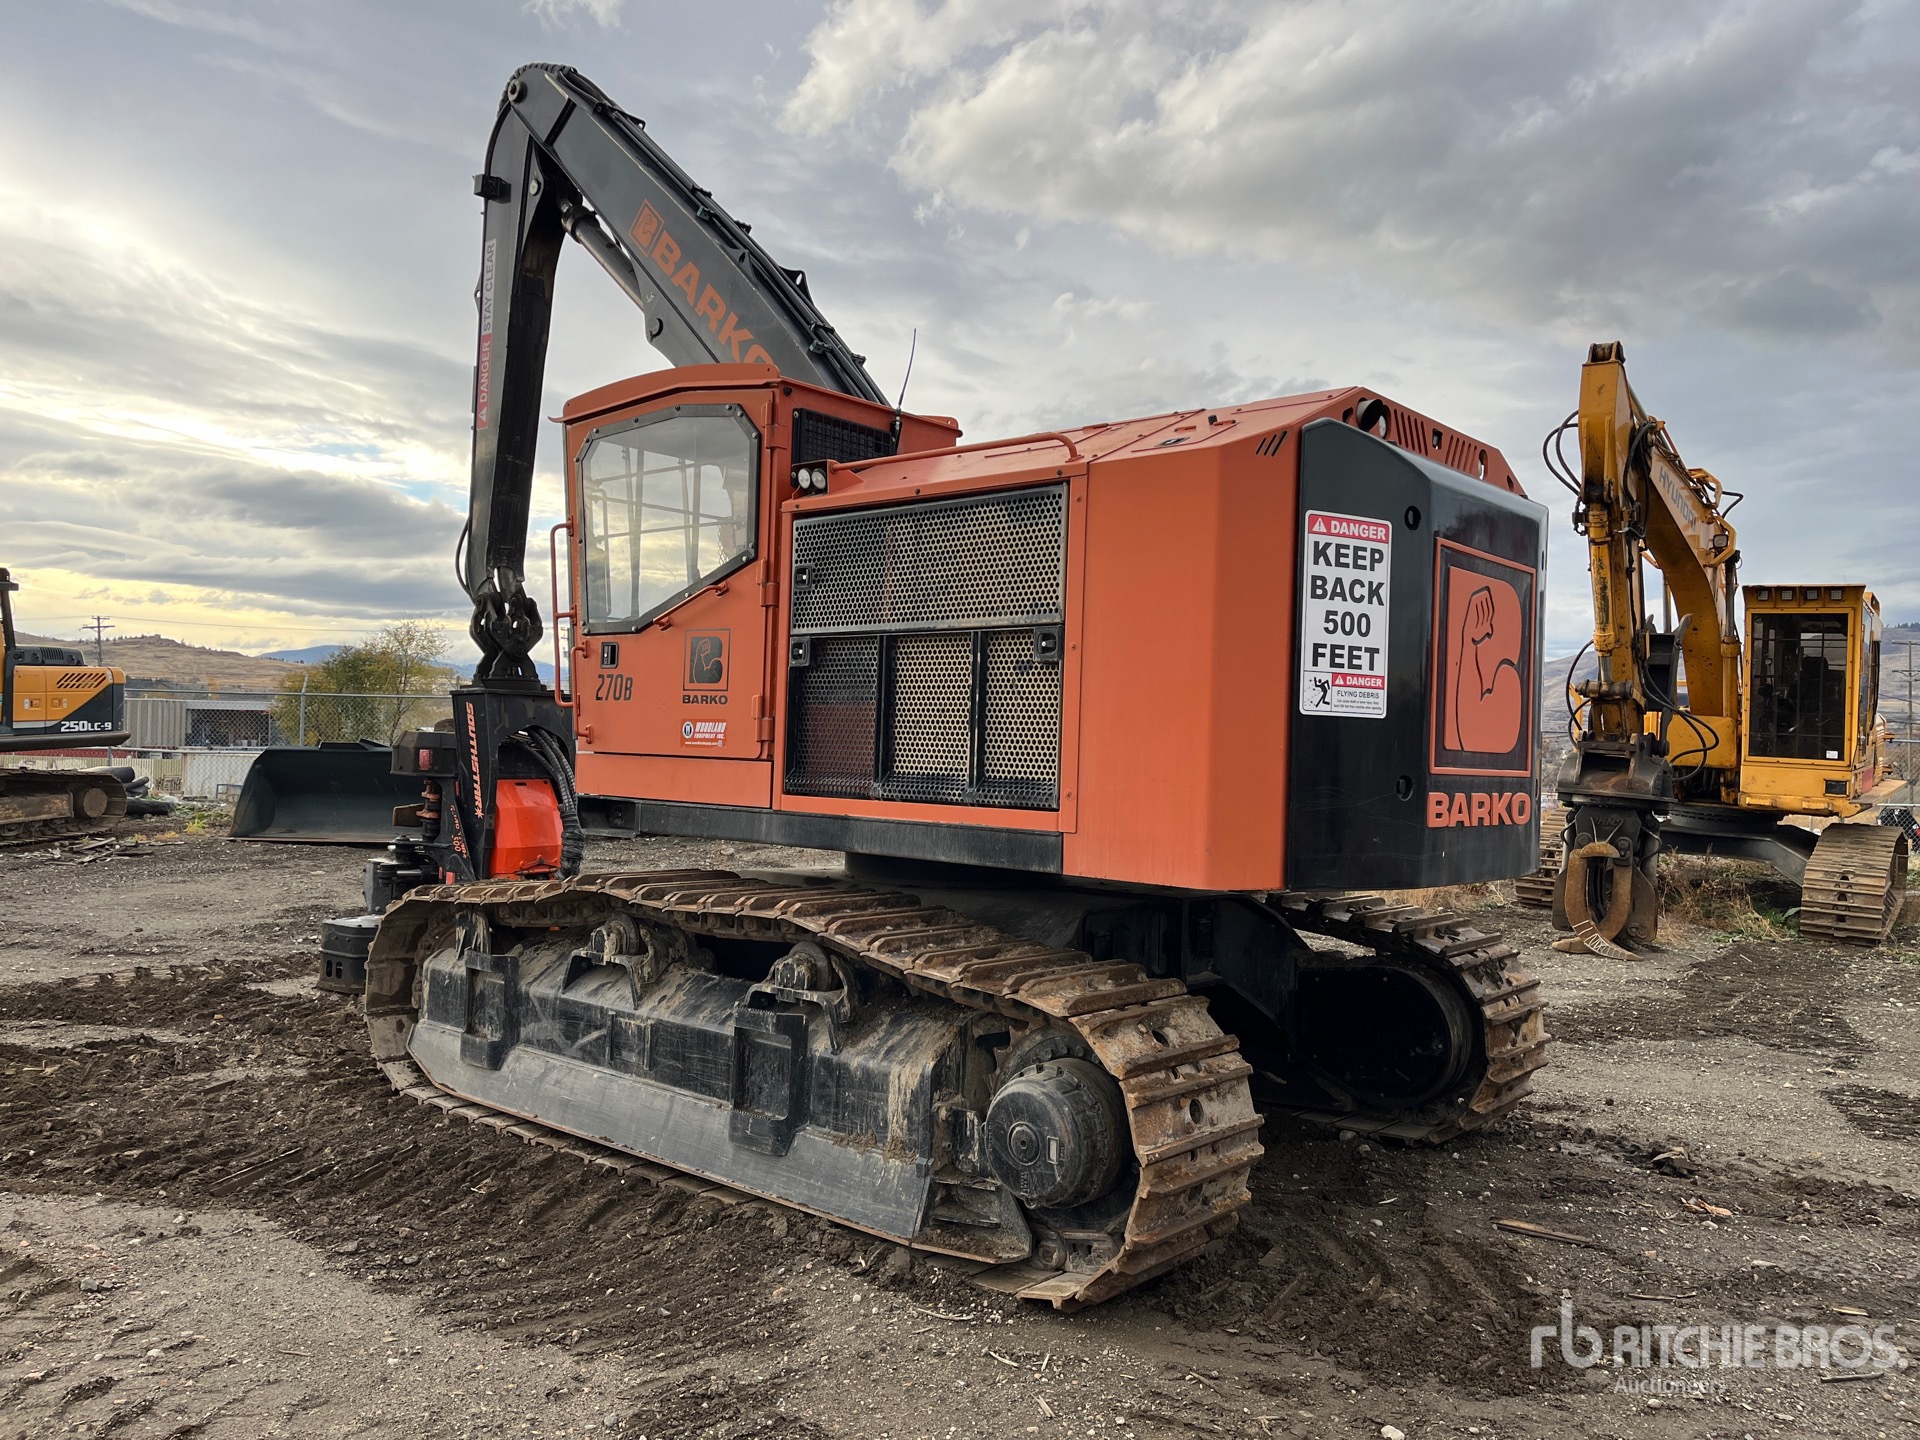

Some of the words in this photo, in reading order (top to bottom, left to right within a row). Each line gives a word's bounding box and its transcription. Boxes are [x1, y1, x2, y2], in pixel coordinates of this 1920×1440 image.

[486, 243, 495, 292] CLEAR
[483, 297, 492, 332] STAY
[479, 341, 490, 403] DANGER
[1658, 466, 1697, 532] HYUNDAI
[1330, 520, 1386, 541] DANGER
[1313, 540, 1384, 572] KEEP
[1310, 574, 1385, 606] BACK
[1323, 609, 1371, 638] 500
[1312, 642, 1380, 671] FEET
[595, 673, 633, 701] 270B
[1336, 690, 1358, 698] FLYING
[1358, 691, 1380, 699] DEBRIS
[1346, 676, 1382, 687] DANGER
[682, 694, 729, 705] BARKO
[60, 720, 112, 732] 250LC-9
[466, 701, 482, 809] SOUTHSTAR
[1426, 791, 1531, 828] BARKO
